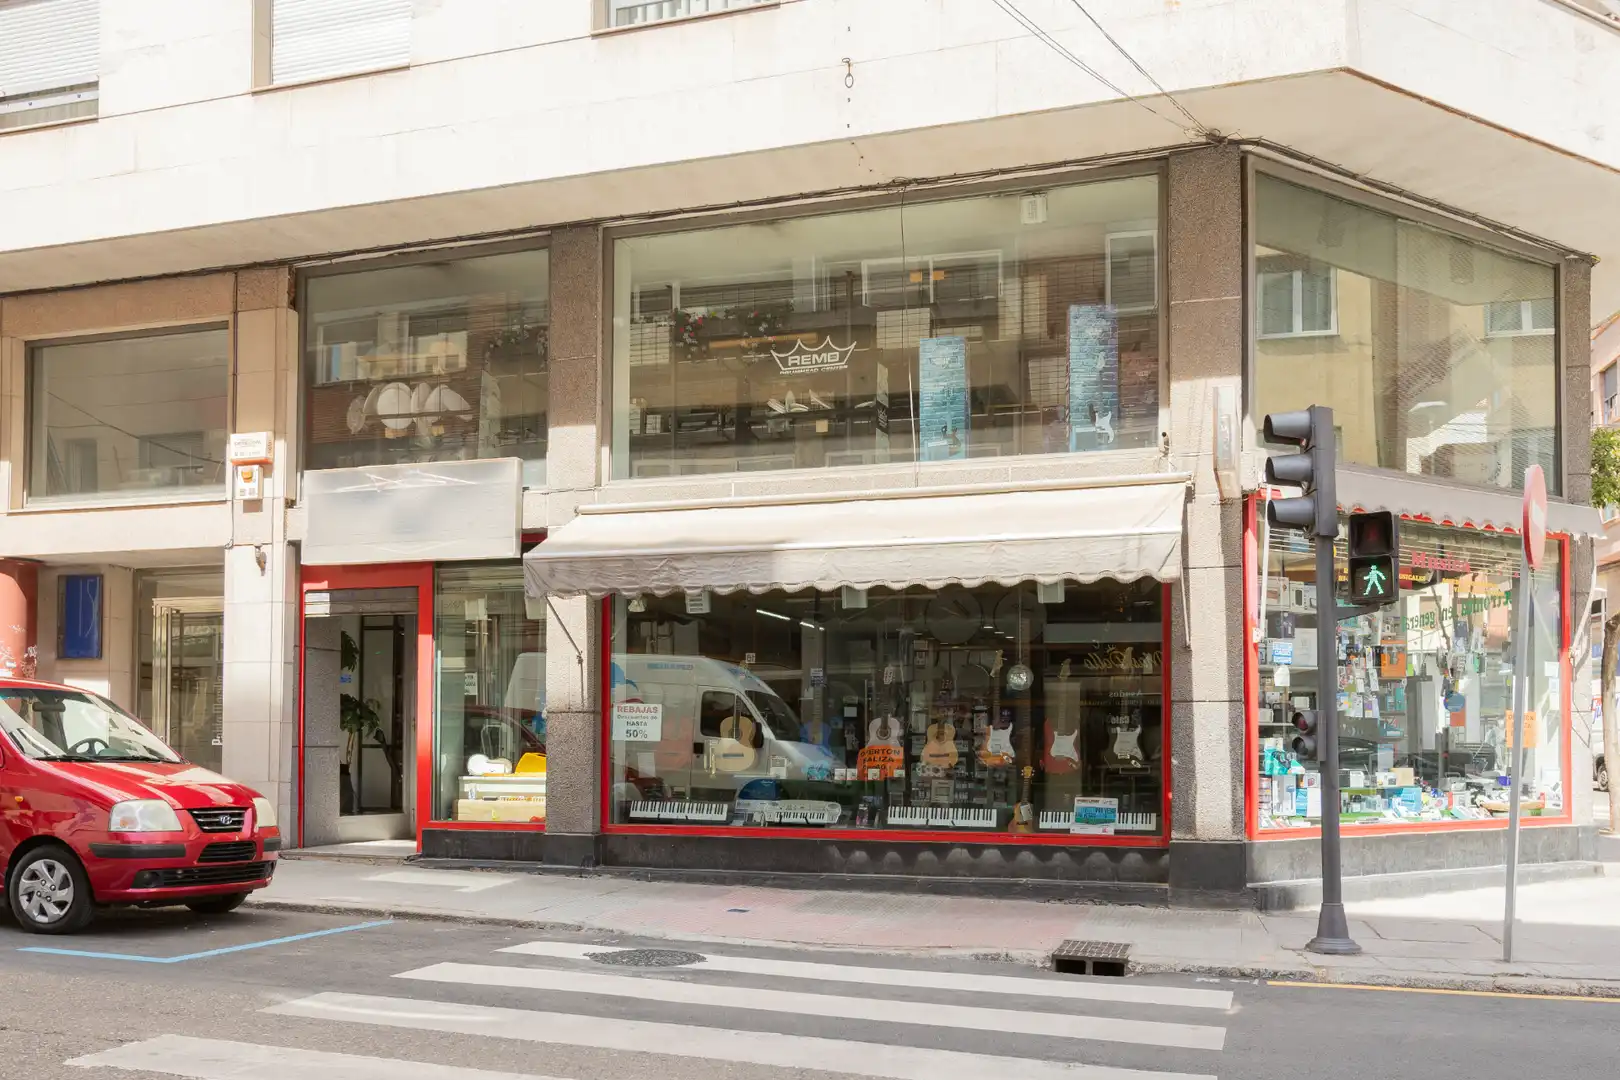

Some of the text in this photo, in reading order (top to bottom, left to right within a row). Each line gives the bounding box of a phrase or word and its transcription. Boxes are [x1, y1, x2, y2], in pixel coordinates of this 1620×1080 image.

[788, 352, 840, 366] REMO
[617, 706, 658, 714] REBAJAS
[626, 730, 648, 738] 50%
